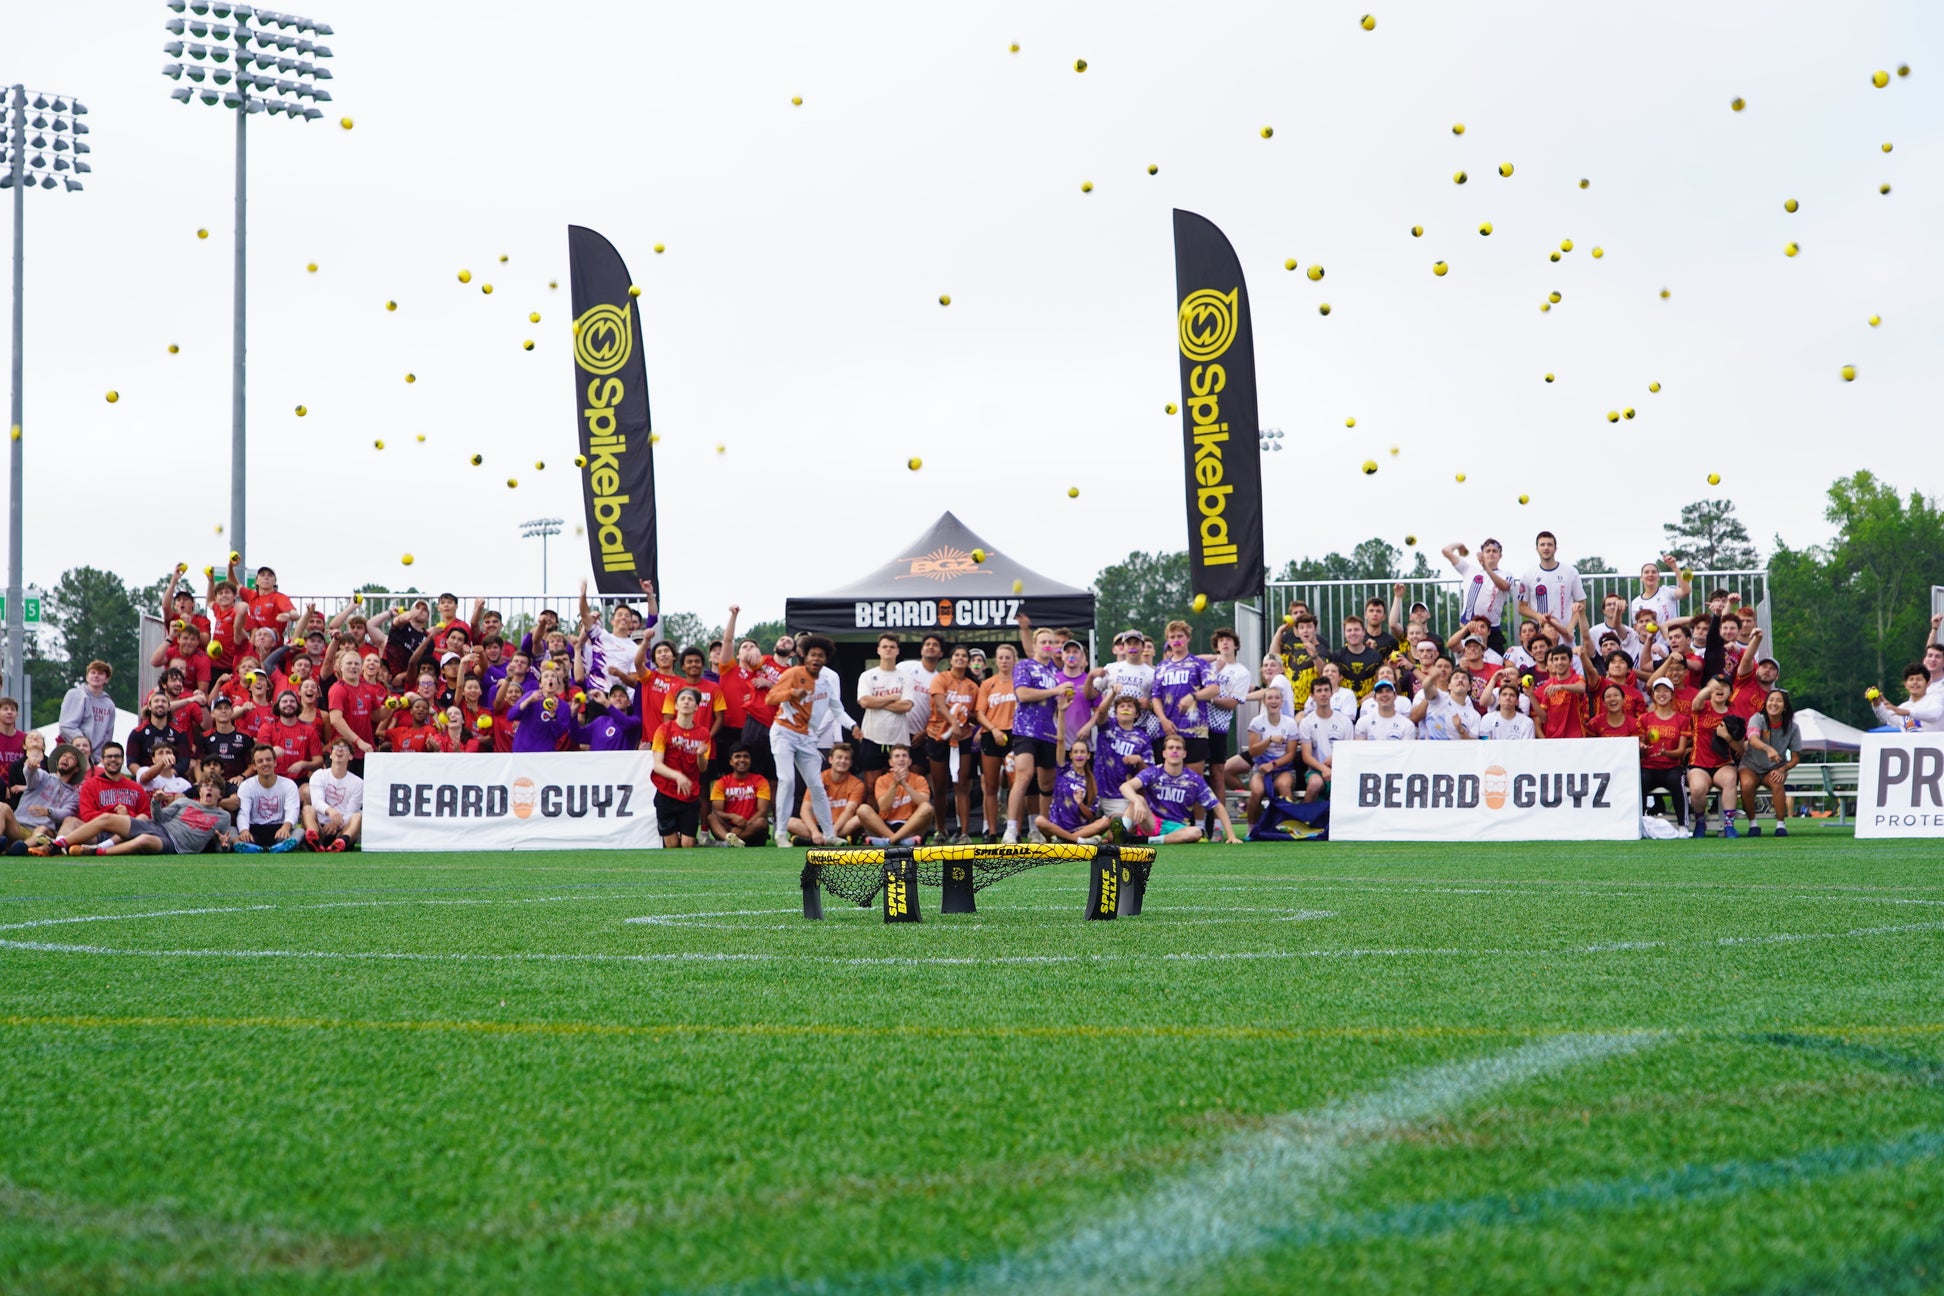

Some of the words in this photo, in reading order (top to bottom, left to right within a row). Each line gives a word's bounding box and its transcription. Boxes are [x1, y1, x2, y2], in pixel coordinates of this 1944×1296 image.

[584, 377, 636, 573] Spikeball
[1187, 363, 1238, 566] Spikeball
[910, 557, 979, 576] BGZ
[855, 600, 937, 628] BEARD
[955, 599, 1019, 626] GUYZ
[1161, 670, 1190, 686] JMU
[1110, 739, 1136, 757] JMU
[389, 783, 509, 818] BEARD
[541, 784, 634, 818] GUYZ
[1156, 786, 1186, 803] JMU
[1358, 773, 1481, 808] BEARD
[1513, 772, 1611, 809] GUYZ
[974, 847, 1032, 856] SPIKEBALL
[1100, 868, 1110, 914] SPIKE
[1109, 875, 1117, 912] BALL
